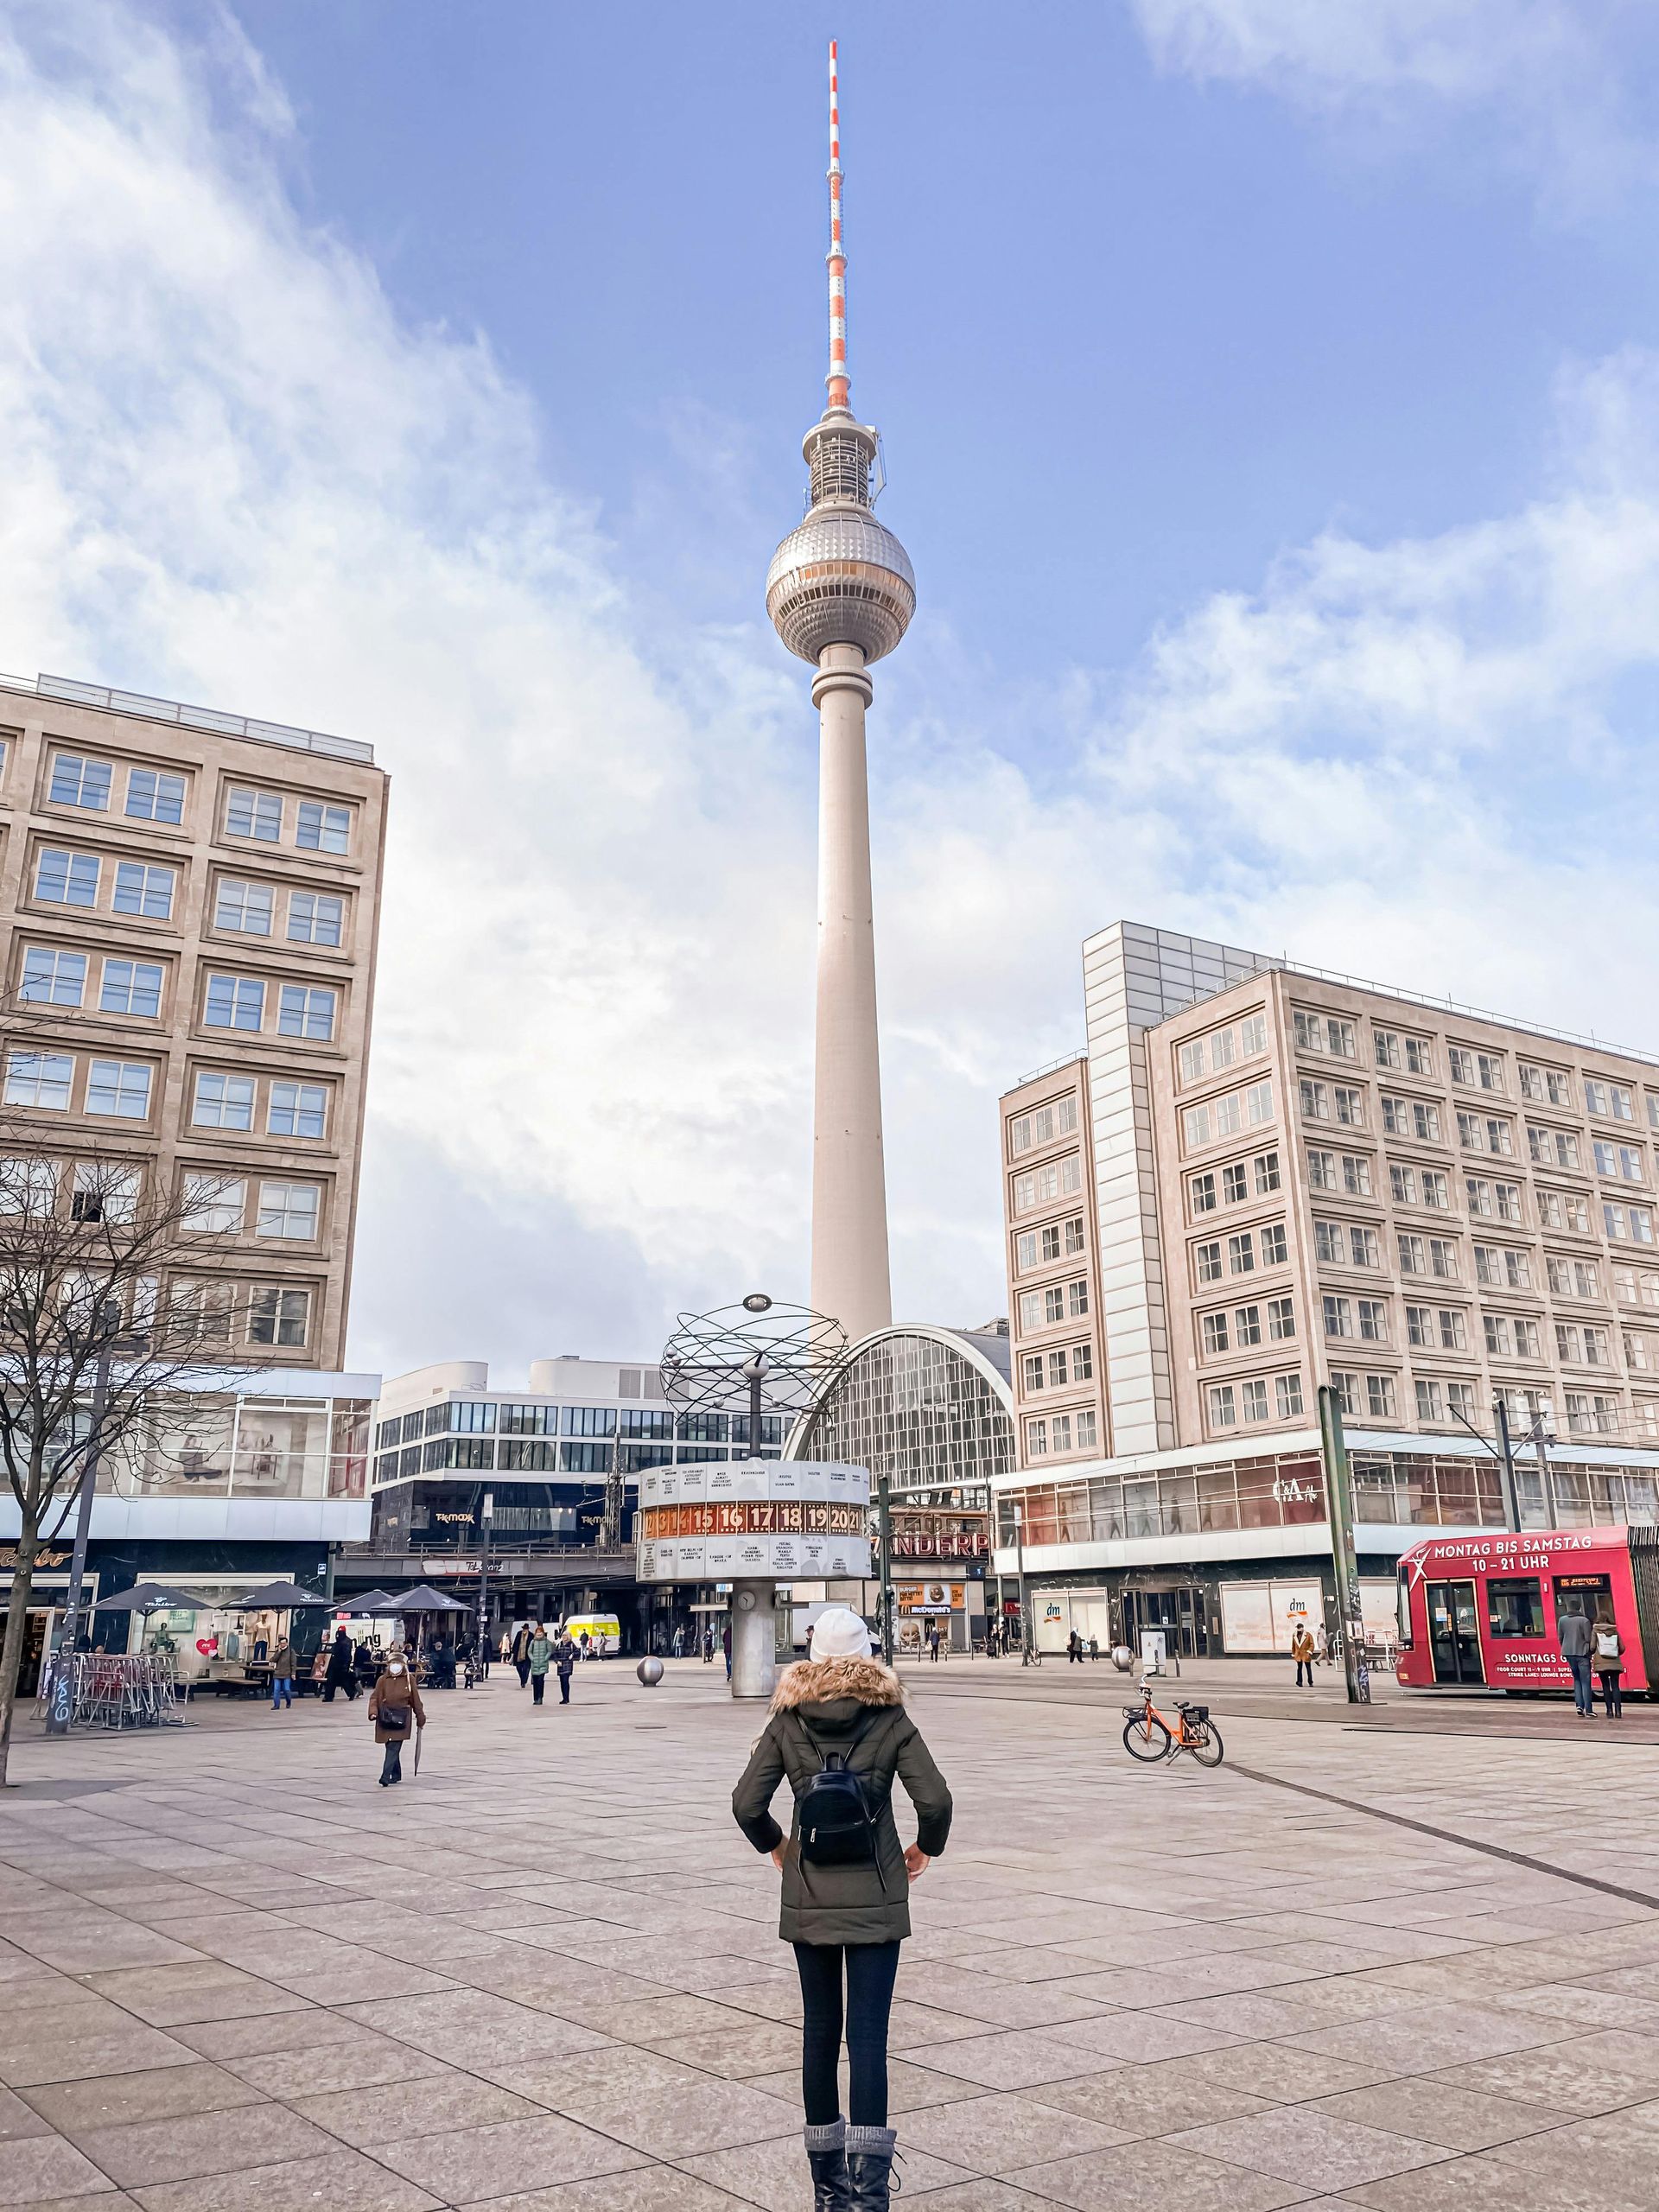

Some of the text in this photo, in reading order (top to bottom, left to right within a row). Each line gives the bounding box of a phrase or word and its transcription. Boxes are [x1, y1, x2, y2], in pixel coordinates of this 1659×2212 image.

[1273, 1478, 1304, 1503] C&A
[671, 1511, 687, 1529] 14
[694, 1509, 714, 1528] 15
[721, 1508, 743, 1527] 16
[751, 1507, 774, 1527] 17
[781, 1507, 802, 1527] 18
[809, 1509, 828, 1527] 19
[831, 1509, 848, 1529] 20
[849, 1511, 859, 1529] 21
[1434, 1535, 1592, 1559] MONTAG BIS SAMSTAG
[1472, 1559, 1486, 1572] 10
[1501, 1557, 1516, 1570] 21
[1520, 1555, 1549, 1569] UHR
[1046, 1602, 1060, 1616] dm
[1289, 1598, 1306, 1611] dm
[1504, 1653, 1557, 1663] SONNTAGS
